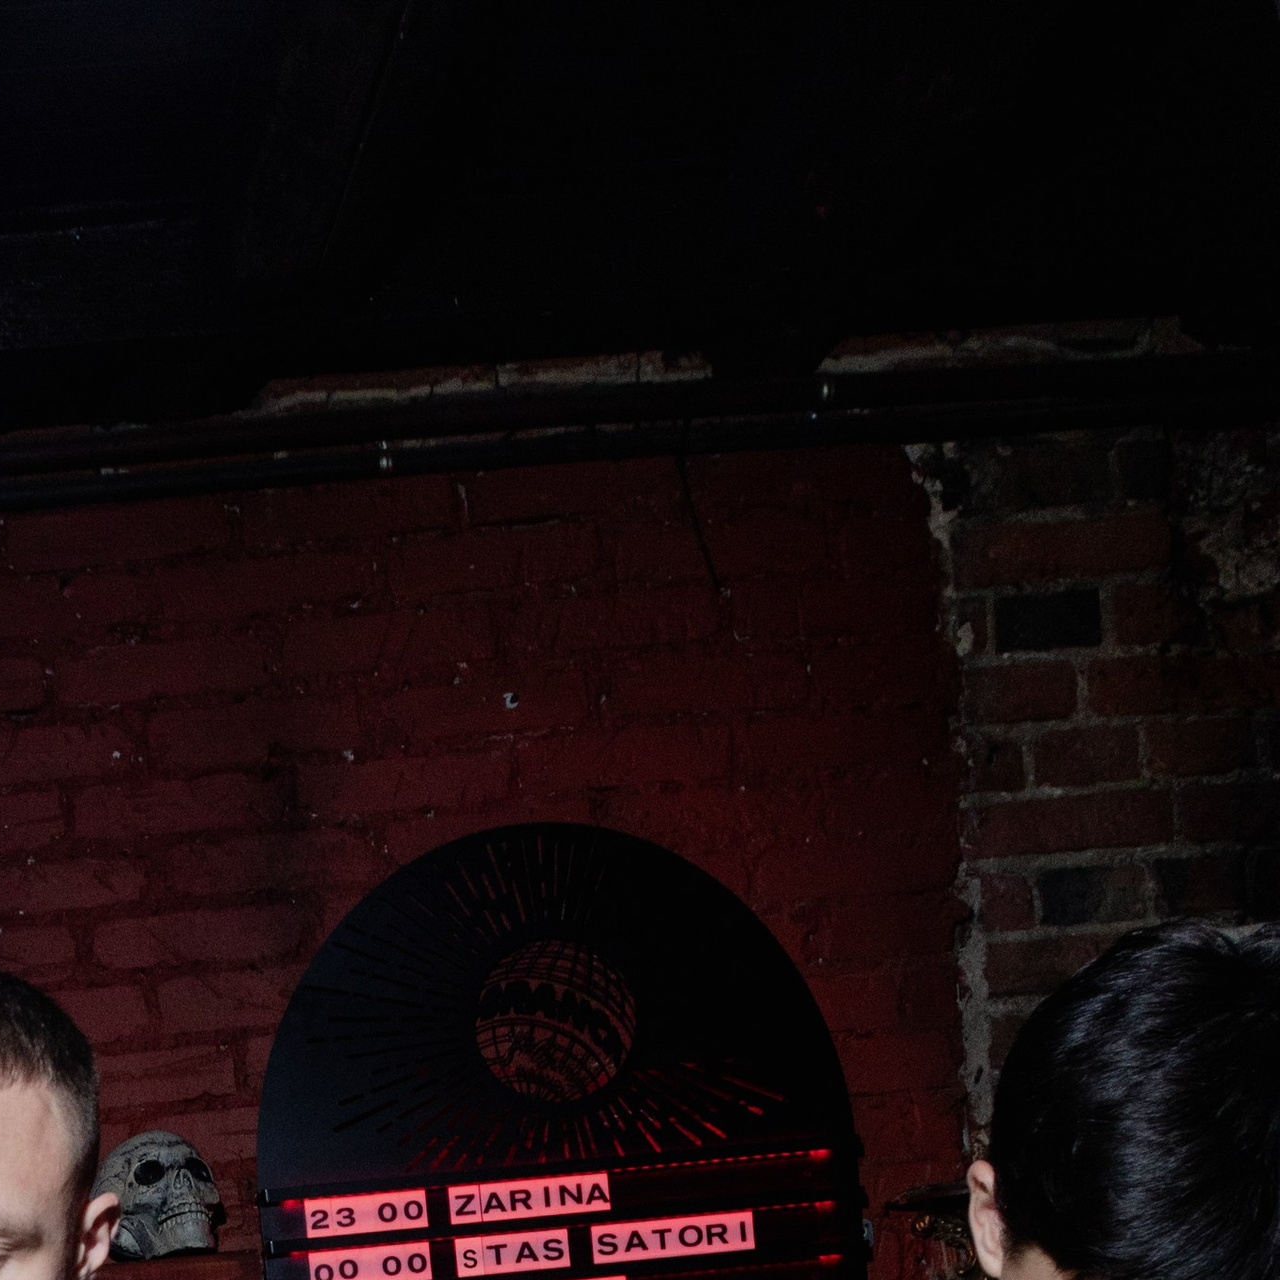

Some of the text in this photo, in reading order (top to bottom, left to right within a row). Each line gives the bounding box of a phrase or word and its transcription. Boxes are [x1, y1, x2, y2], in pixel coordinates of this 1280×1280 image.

[310, 1183, 610, 1230] 23 00 ZARINA
[382, 1253, 428, 1276] 00
[597, 1221, 747, 1256] SATORI
